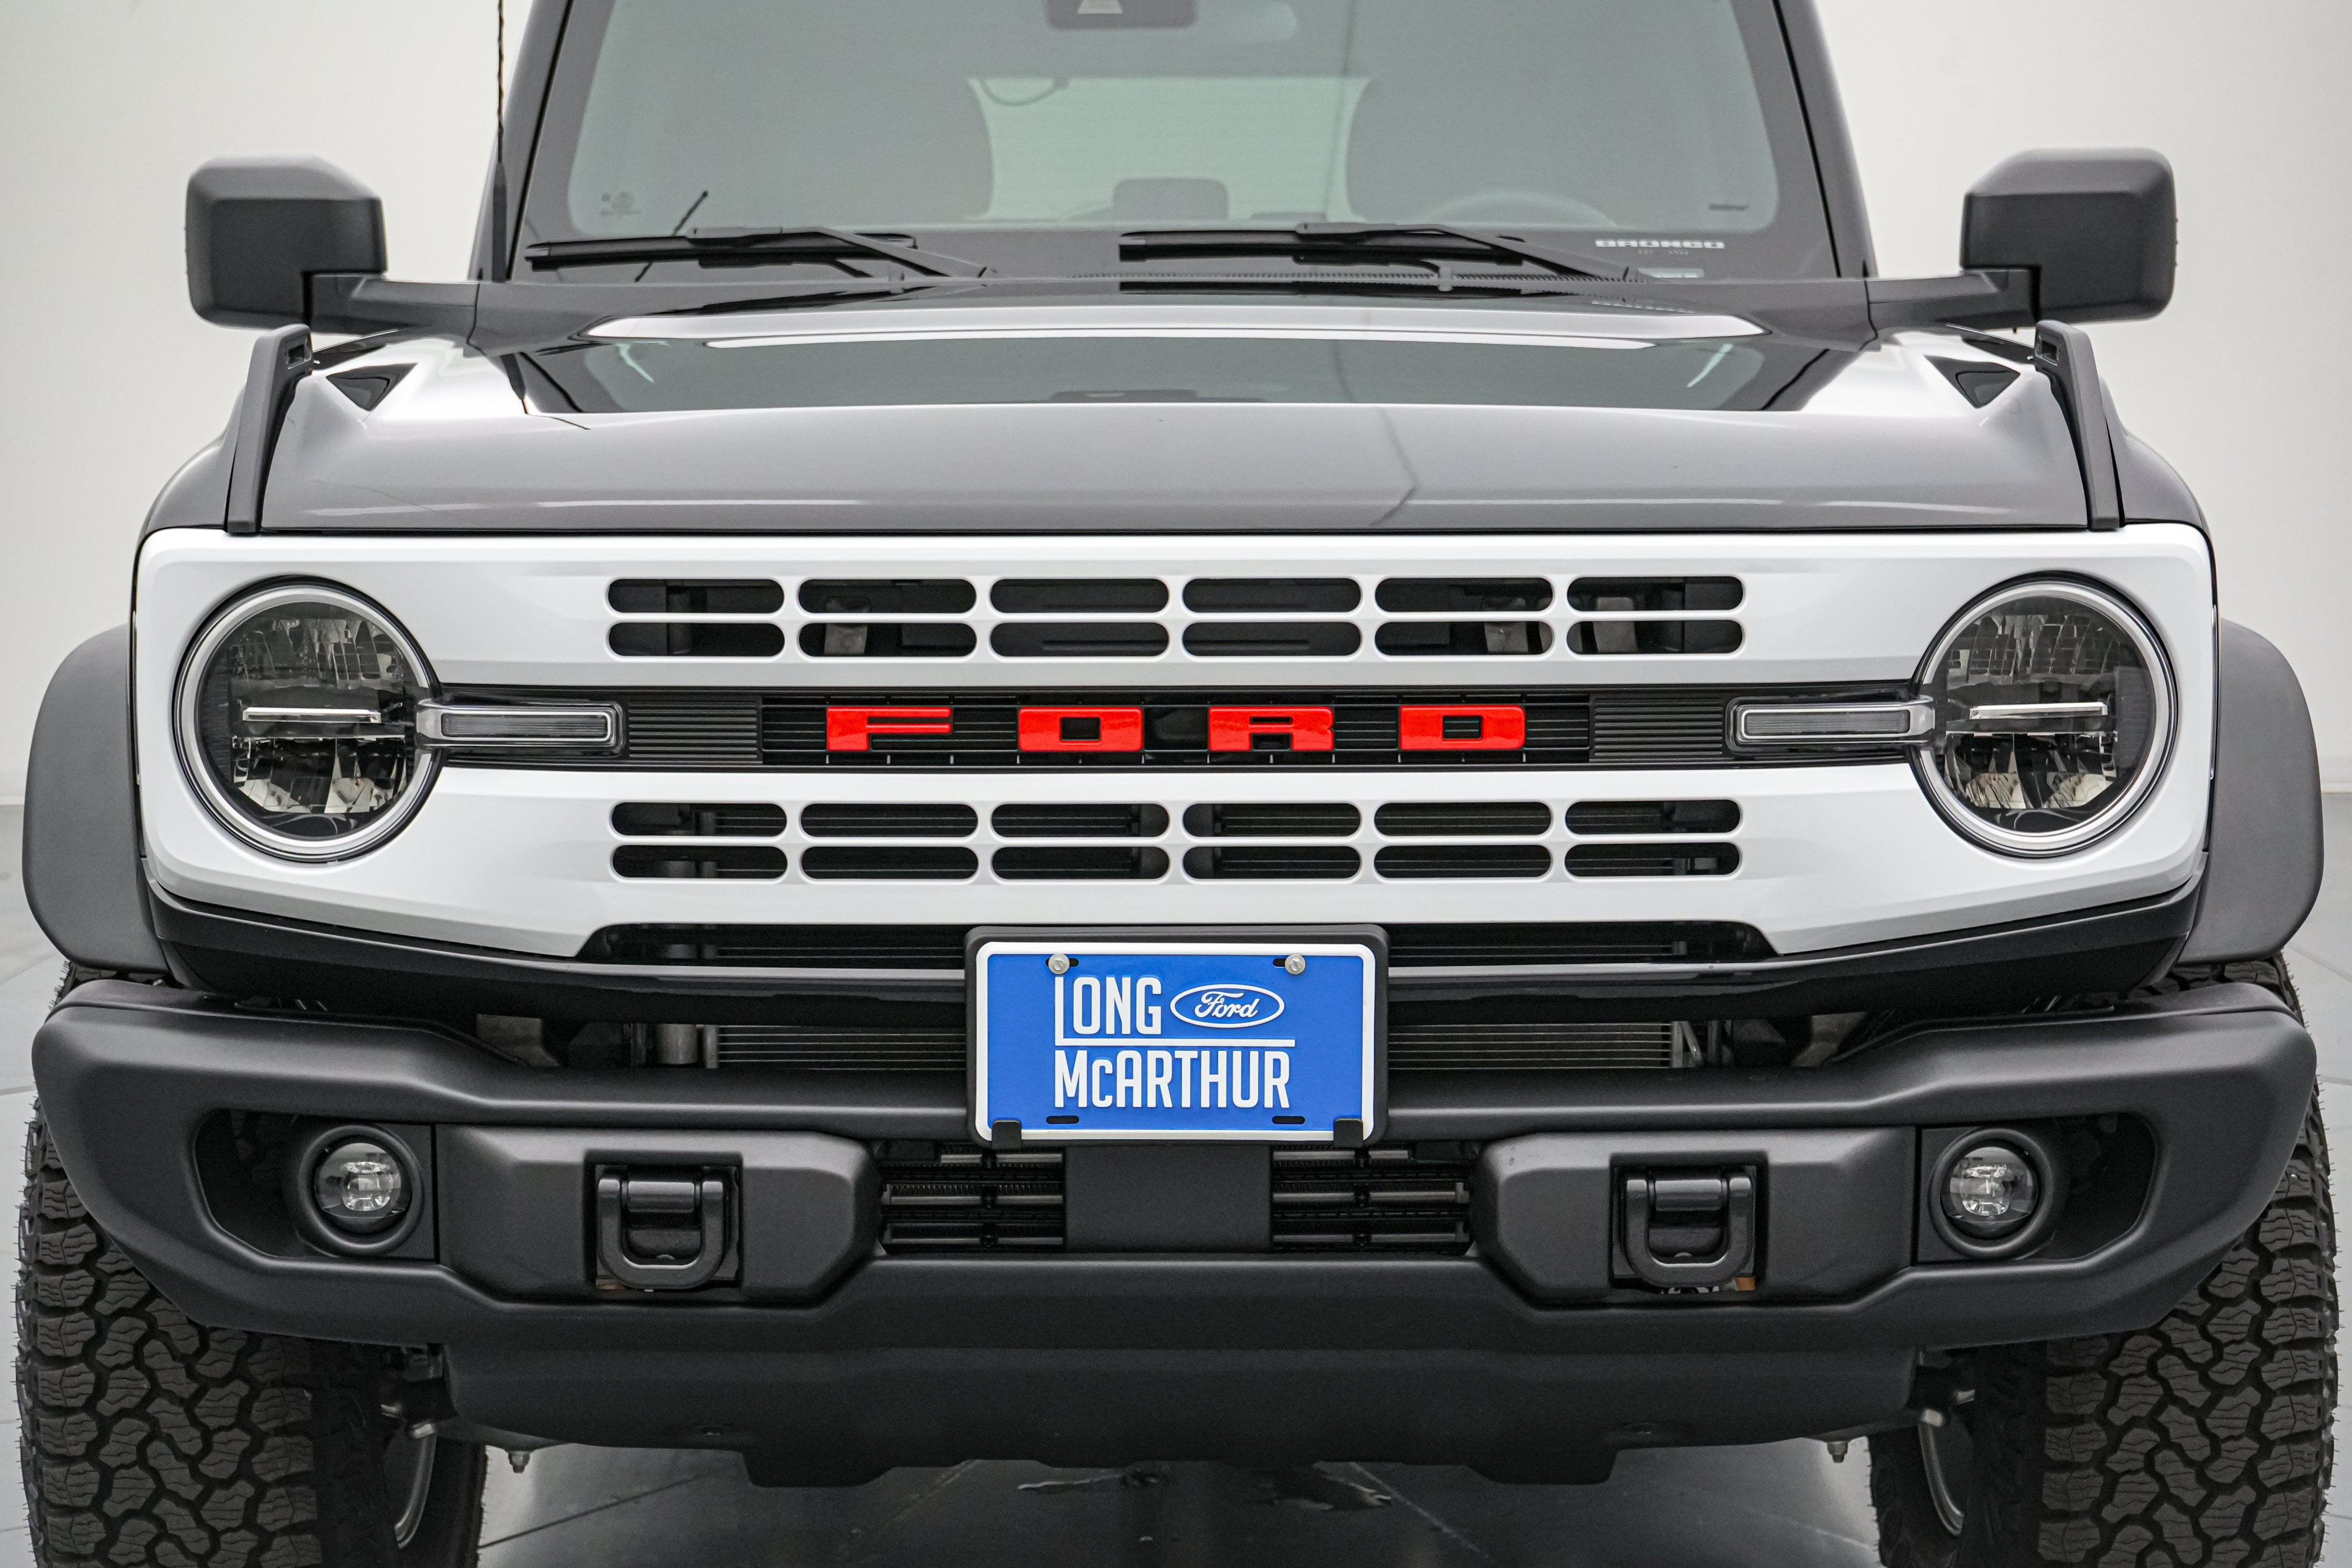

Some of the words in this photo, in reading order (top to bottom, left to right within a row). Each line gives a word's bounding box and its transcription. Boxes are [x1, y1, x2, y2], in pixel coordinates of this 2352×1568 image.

[1595, 239, 1725, 249] BRONCO
[826, 704, 1525, 751] FORD
[1054, 976, 1162, 1044] LONG
[1194, 991, 1259, 1019] Ford
[1054, 1049, 1290, 1108] McARTHUR
